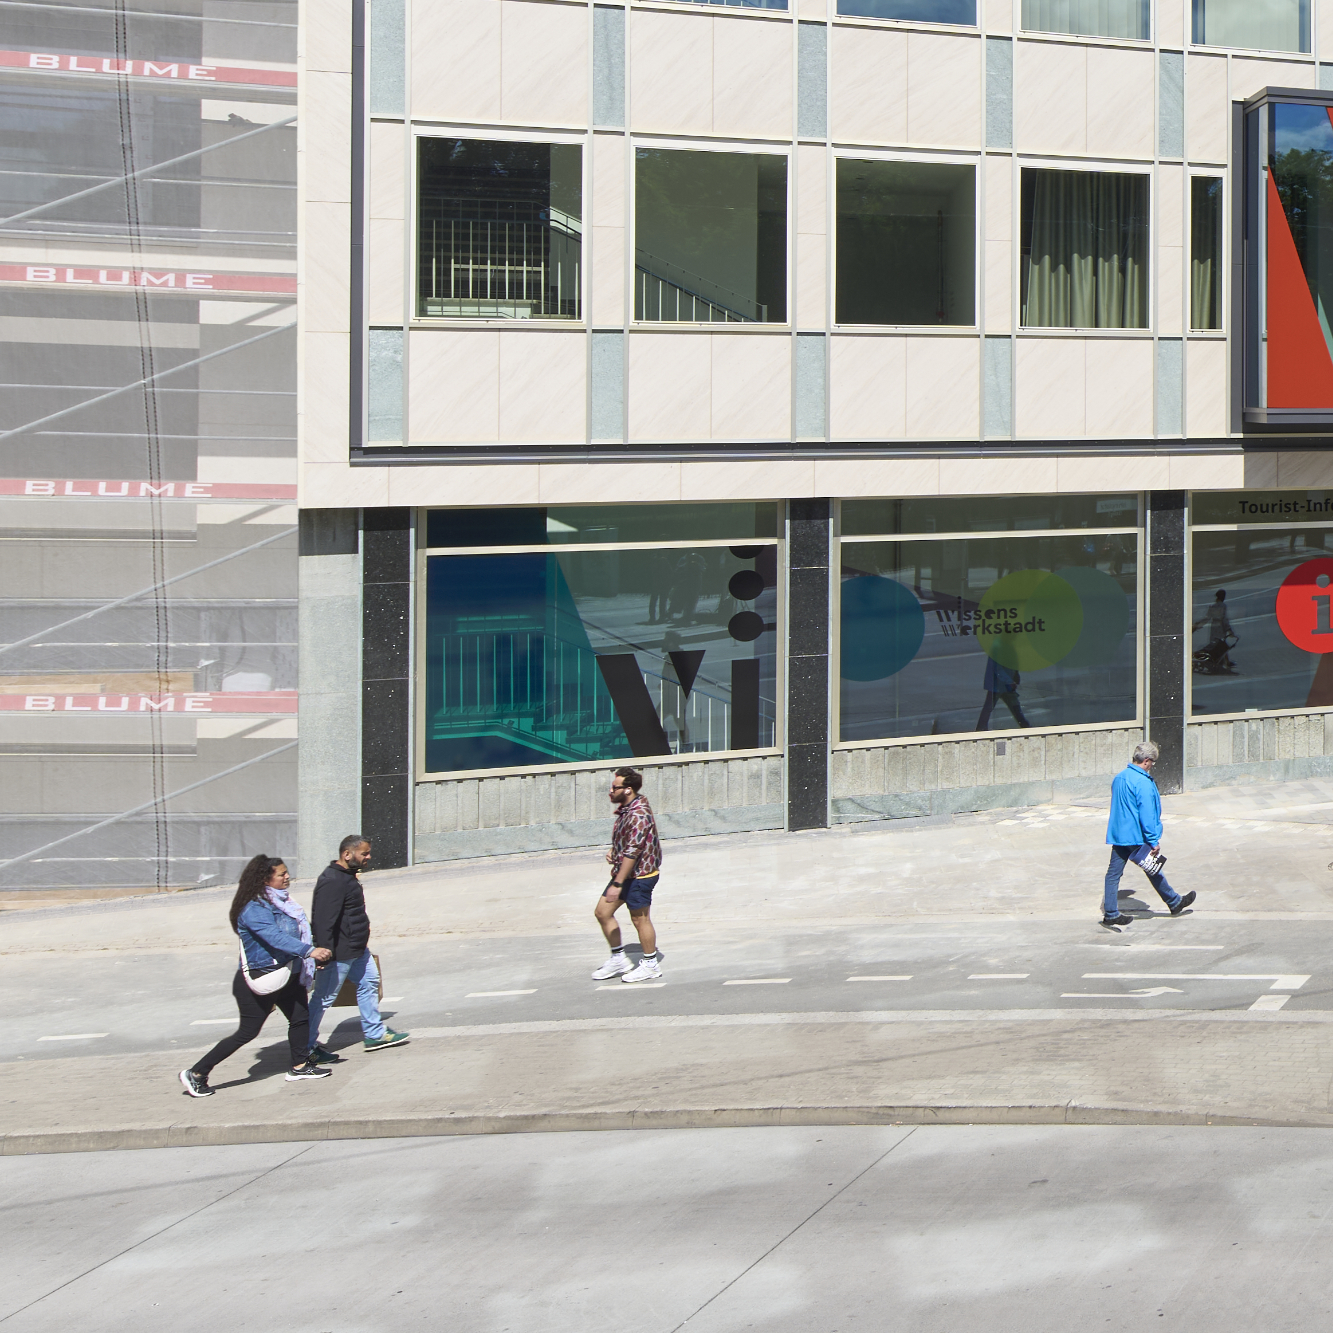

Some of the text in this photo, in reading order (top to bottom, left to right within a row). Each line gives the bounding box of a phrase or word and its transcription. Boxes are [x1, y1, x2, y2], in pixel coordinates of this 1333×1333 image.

[29, 54, 216, 80] BLUME
[25, 267, 213, 289] BLUME
[24, 481, 213, 497] BLUME
[936, 595, 1019, 622] Wissens
[941, 616, 1046, 636] Werkstadt
[24, 695, 212, 711] BLUME
